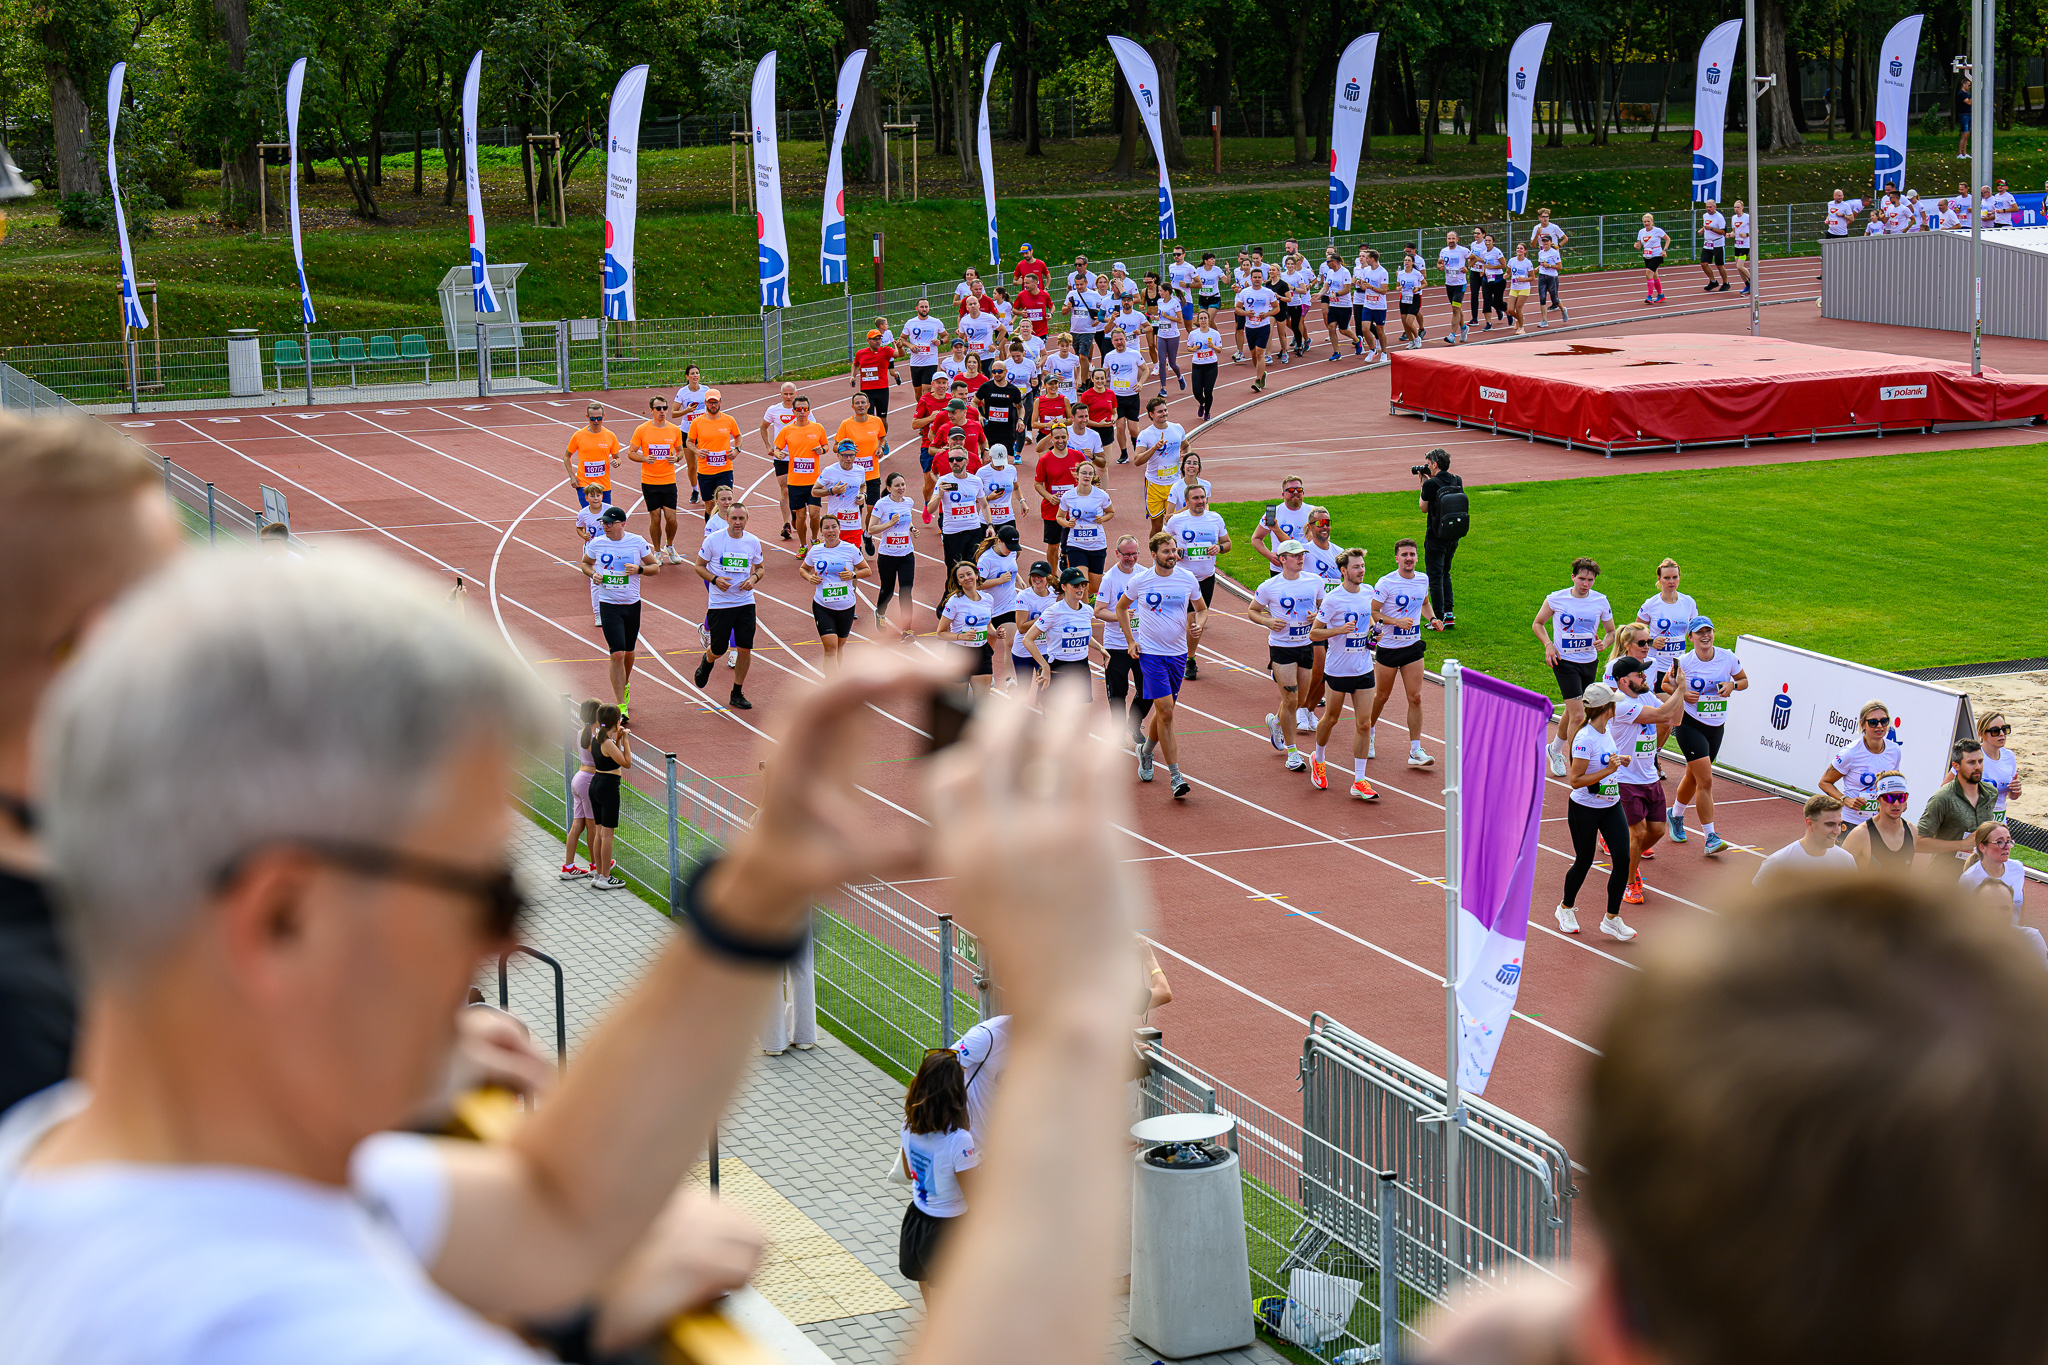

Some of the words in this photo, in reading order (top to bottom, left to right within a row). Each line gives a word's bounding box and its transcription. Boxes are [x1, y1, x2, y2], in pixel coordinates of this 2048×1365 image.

[1893, 387, 1924, 398] polanik
[650, 448, 668, 456] 107/3
[708, 455, 726, 463] 107/5
[586, 465, 604, 473] 107/2
[795, 462, 812, 470] 107/1
[956, 506, 972, 515] 73/5
[991, 507, 1006, 515] 73/3
[1077, 529, 1093, 537] 88/2
[727, 558, 744, 567] 34/2
[607, 576, 625, 584] 34/5
[827, 587, 843, 597] 34/1
[1065, 637, 1087, 648] 102/1
[1567, 639, 1587, 648] 11/3
[1663, 642, 1681, 651] 11/5
[1703, 702, 1722, 711] 20/4
[1829, 710, 1859, 735] Biegaj
[1760, 735, 1774, 749] Bank
[1774, 739, 1791, 753] Polski
